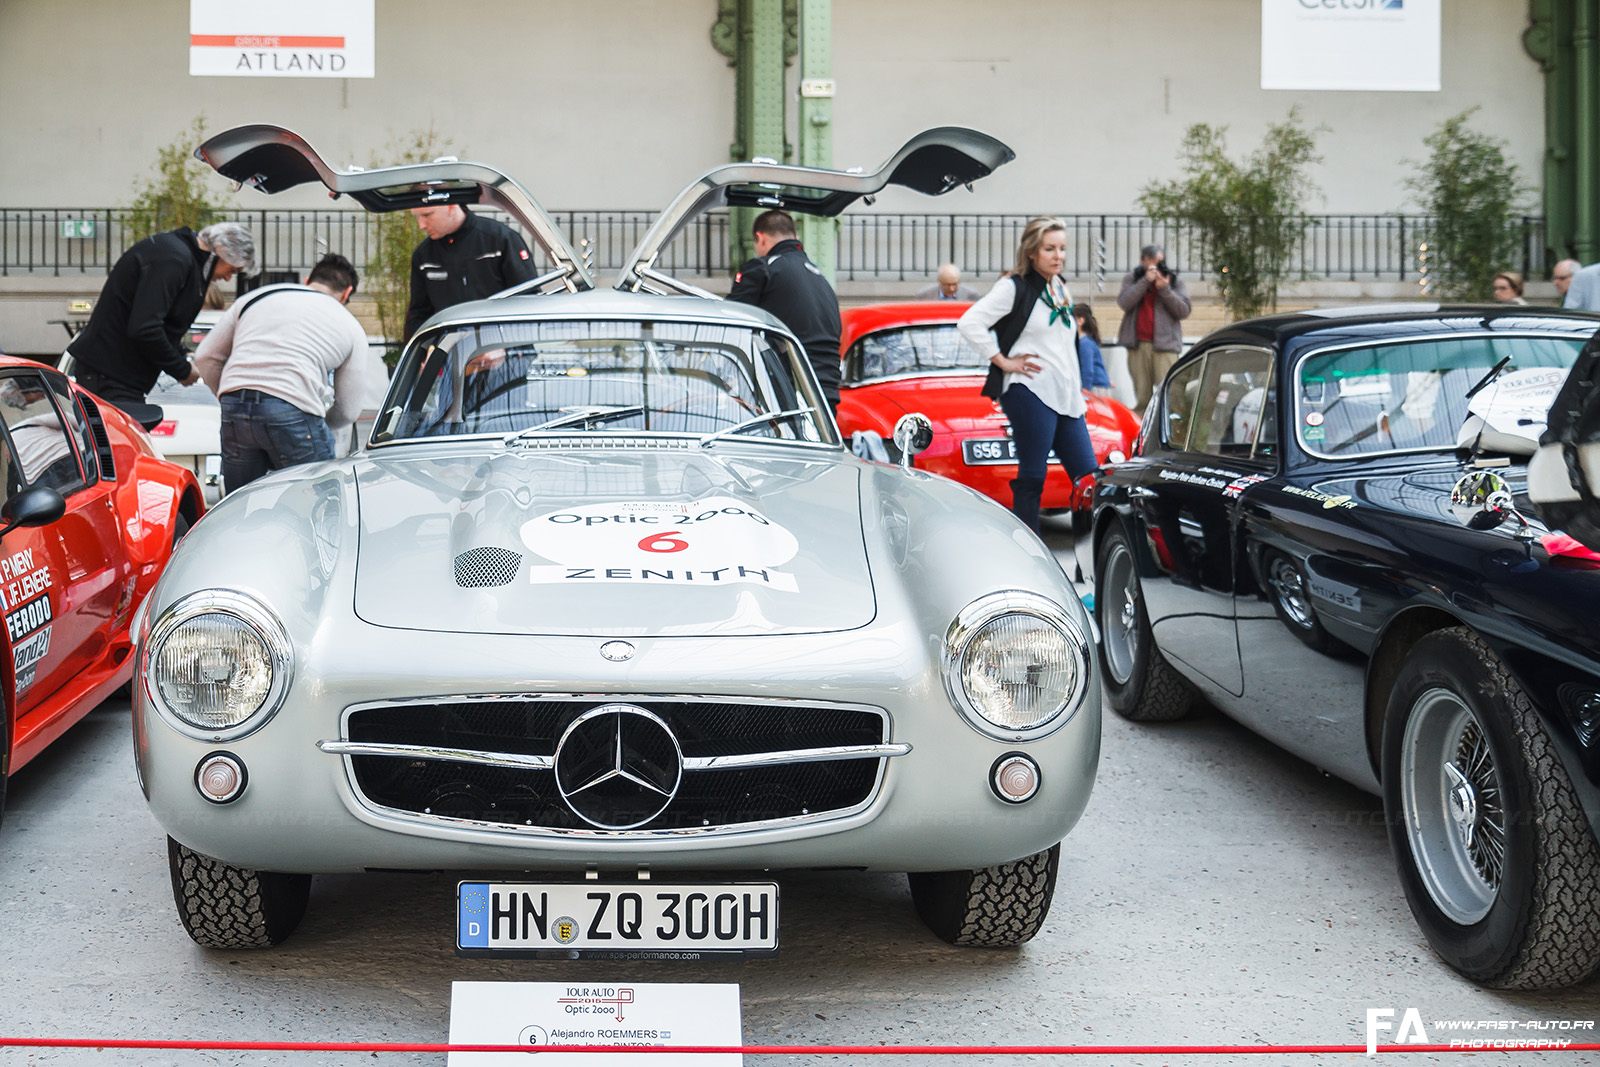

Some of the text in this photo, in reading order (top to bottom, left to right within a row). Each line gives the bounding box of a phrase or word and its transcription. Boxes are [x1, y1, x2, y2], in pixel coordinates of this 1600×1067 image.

[236, 53, 346, 71] ATLAND
[973, 441, 1002, 458] 656
[548, 507, 770, 526] Optic 2000
[637, 531, 690, 553] 6
[565, 566, 770, 583] ZENITH
[6, 596, 51, 642] FERODO
[491, 892, 548, 940] HN
[586, 892, 643, 940] ZQ
[656, 892, 769, 941] 300H
[468, 922, 480, 936] D
[586, 950, 700, 961] www.sps-performance.com
[566, 987, 615, 997] TOUR AUTO
[565, 1004, 615, 1016] Optic 2000
[529, 1034, 537, 1044] 6
[550, 1028, 658, 1040] Alejandro ROEMMERS
